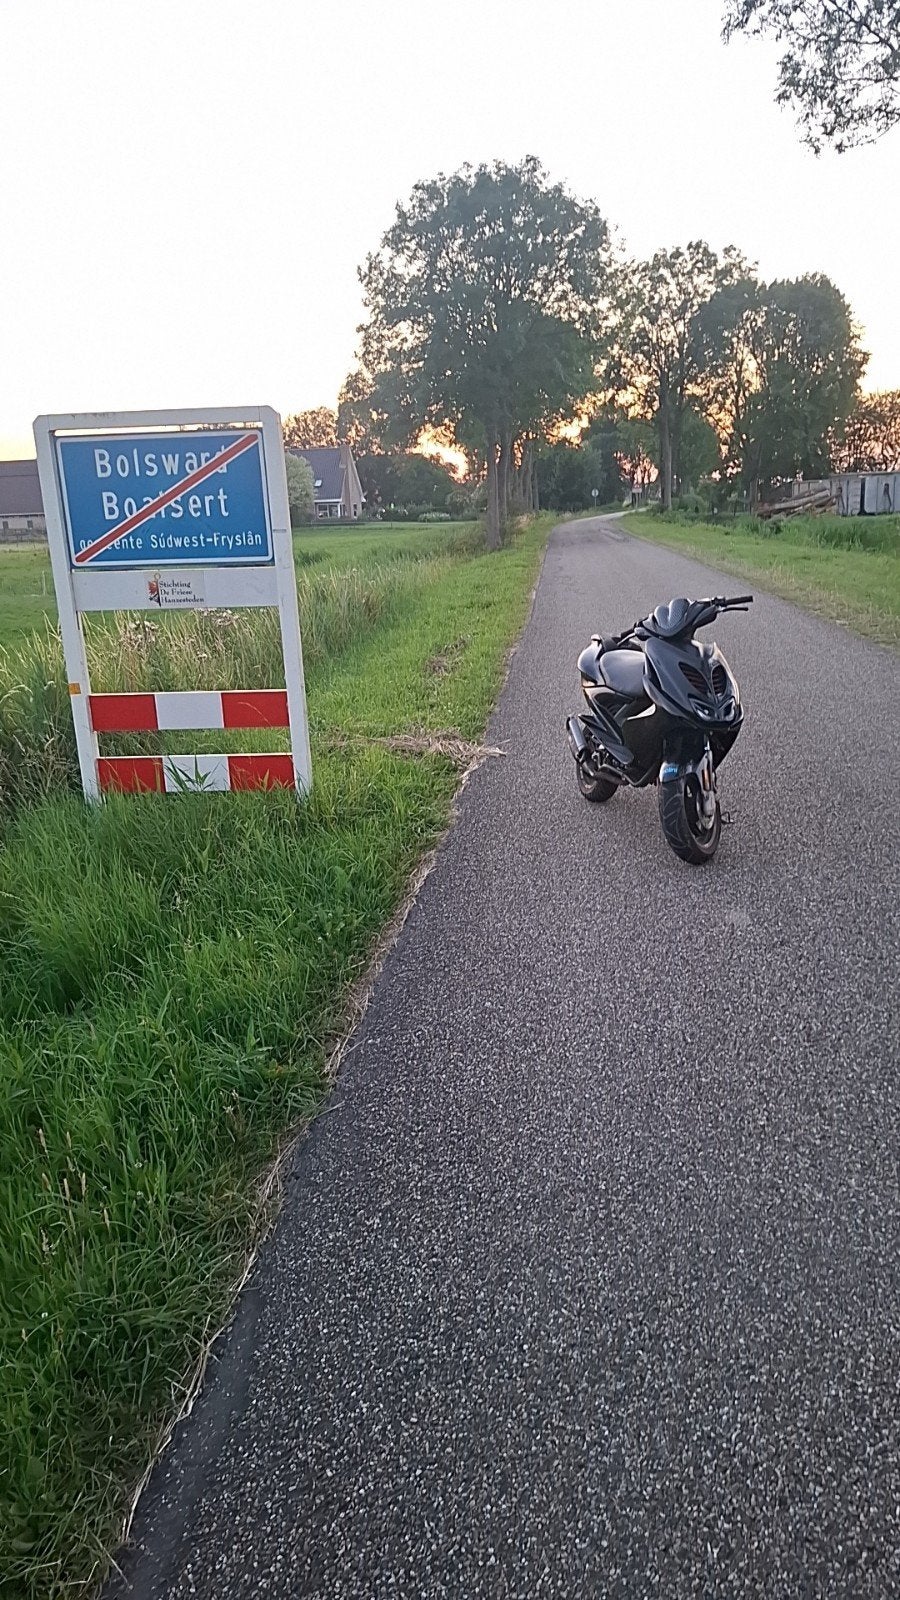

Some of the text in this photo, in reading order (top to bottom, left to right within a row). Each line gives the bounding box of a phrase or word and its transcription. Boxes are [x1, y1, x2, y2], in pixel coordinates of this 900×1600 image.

[94, 445, 228, 478] Bolsward
[79, 531, 262, 551] geente Súdwest-Fryslân
[159, 580, 191, 589] Stichting
[171, 588, 192, 596] Friese
